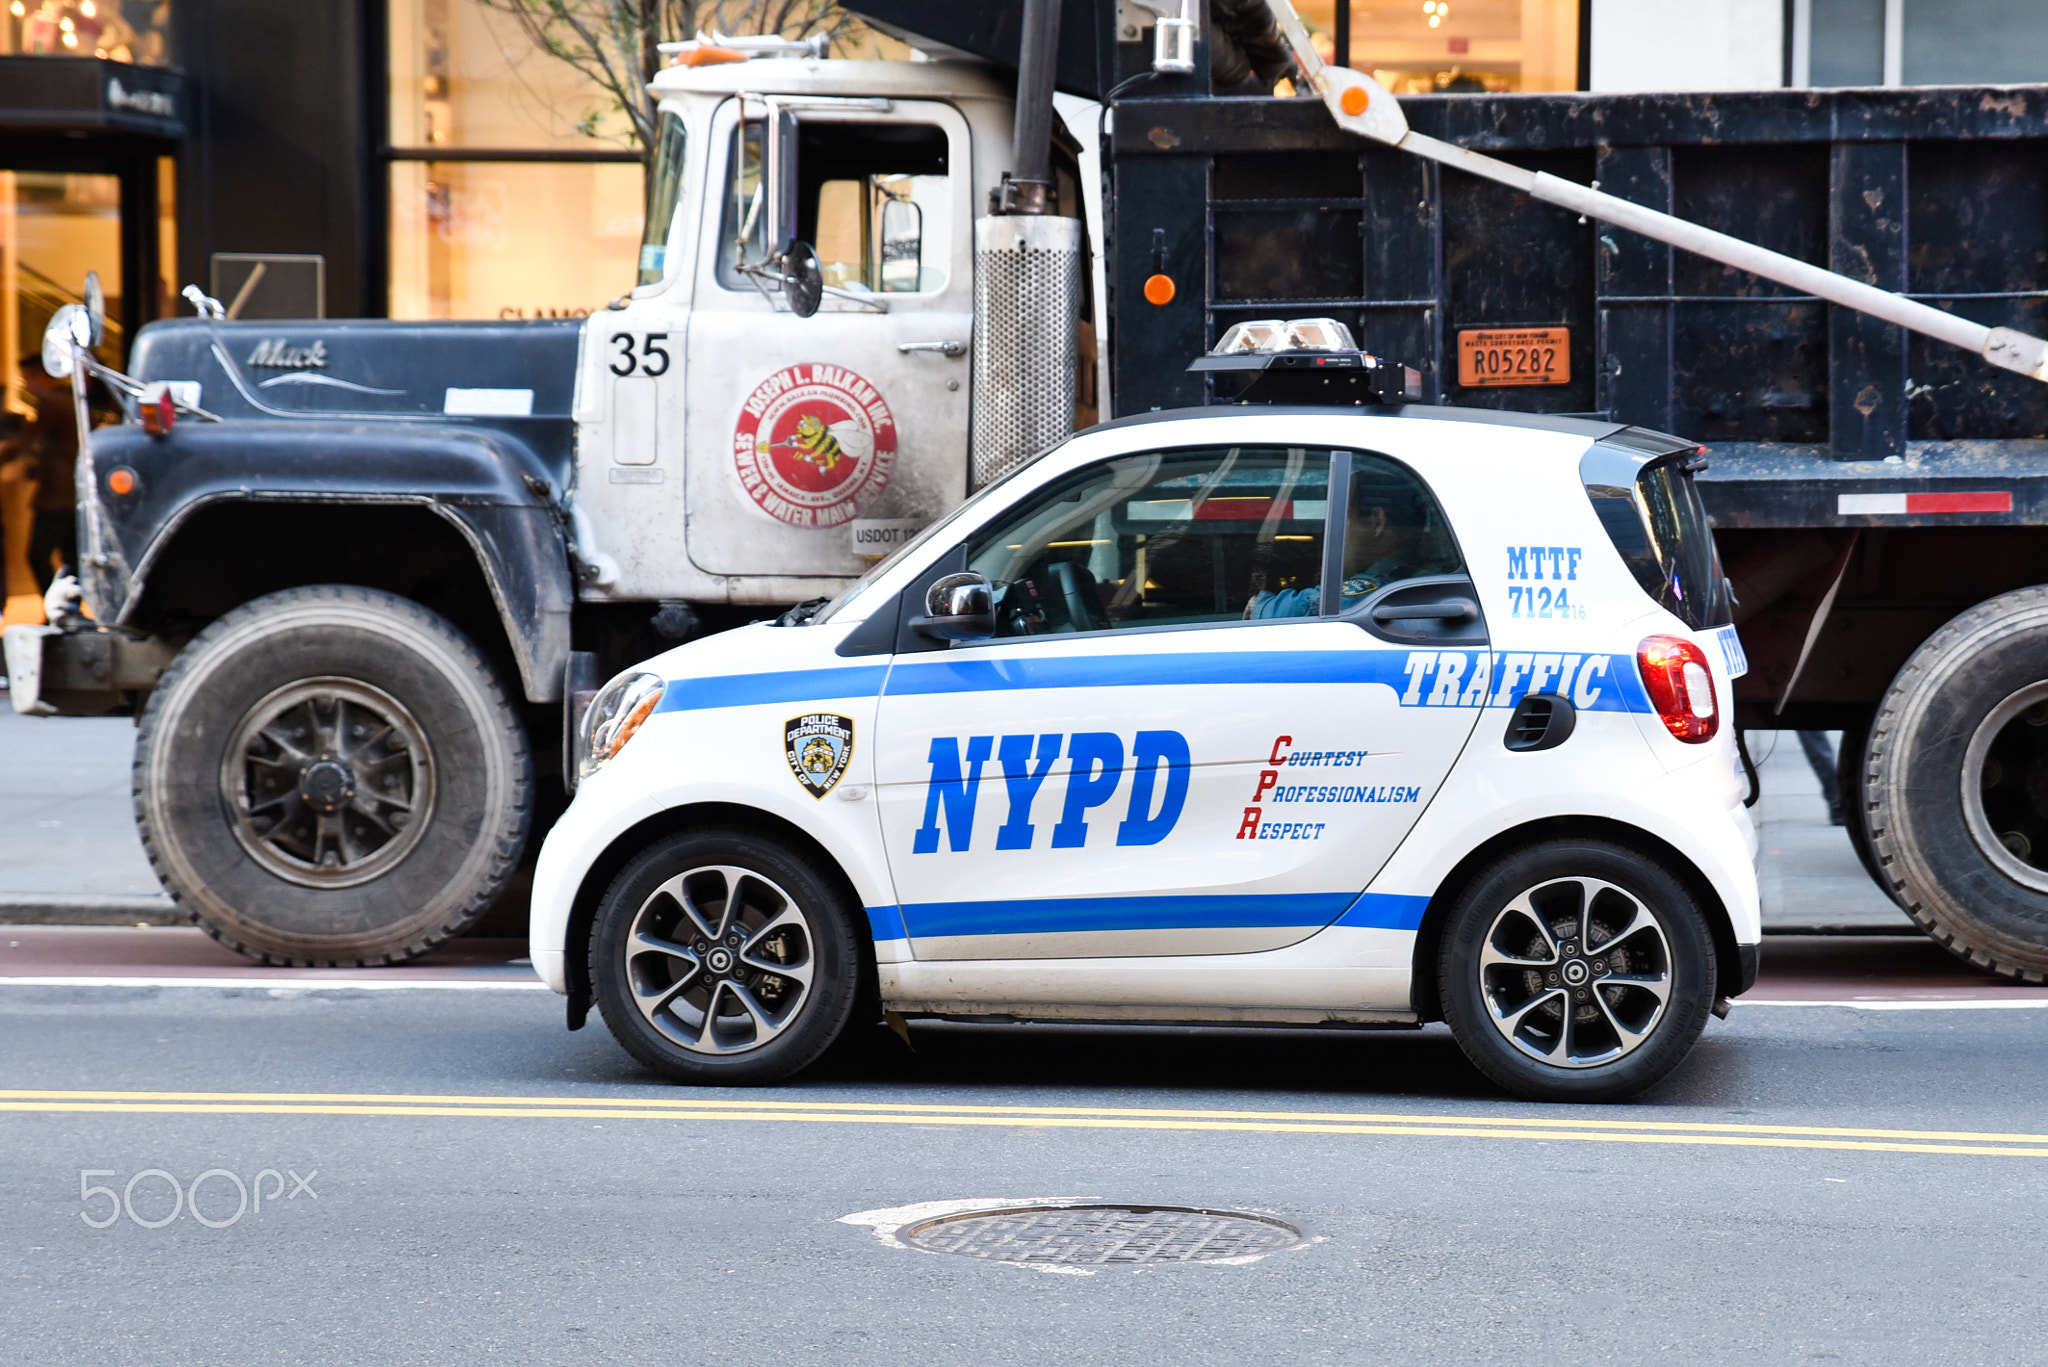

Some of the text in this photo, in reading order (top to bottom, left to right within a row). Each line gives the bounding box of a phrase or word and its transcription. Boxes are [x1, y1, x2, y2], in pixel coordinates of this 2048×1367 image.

[247, 338, 328, 368] Mack
[609, 332, 670, 377] 35
[1474, 347, 1555, 375] R05282
[744, 364, 893, 434] JOSEPH L. BALKAN INC.
[735, 432, 895, 527] SEWER & WATER MAIN SERVICE
[856, 528, 921, 543] USDOT 12
[1506, 546, 1582, 580] MTTF
[1508, 586, 1586, 620] 7124 16
[1400, 651, 1611, 710] TRAFFIC
[786, 724, 852, 742] DEPARTMENT
[800, 714, 840, 727] POLICE
[787, 744, 852, 790] CITY OF NEW YORK
[1268, 735, 1369, 767] COURTESY
[912, 730, 1192, 854] NYPD
[1251, 769, 1422, 803] PROFESSIONALISM
[1235, 806, 1326, 840] RESPECT
